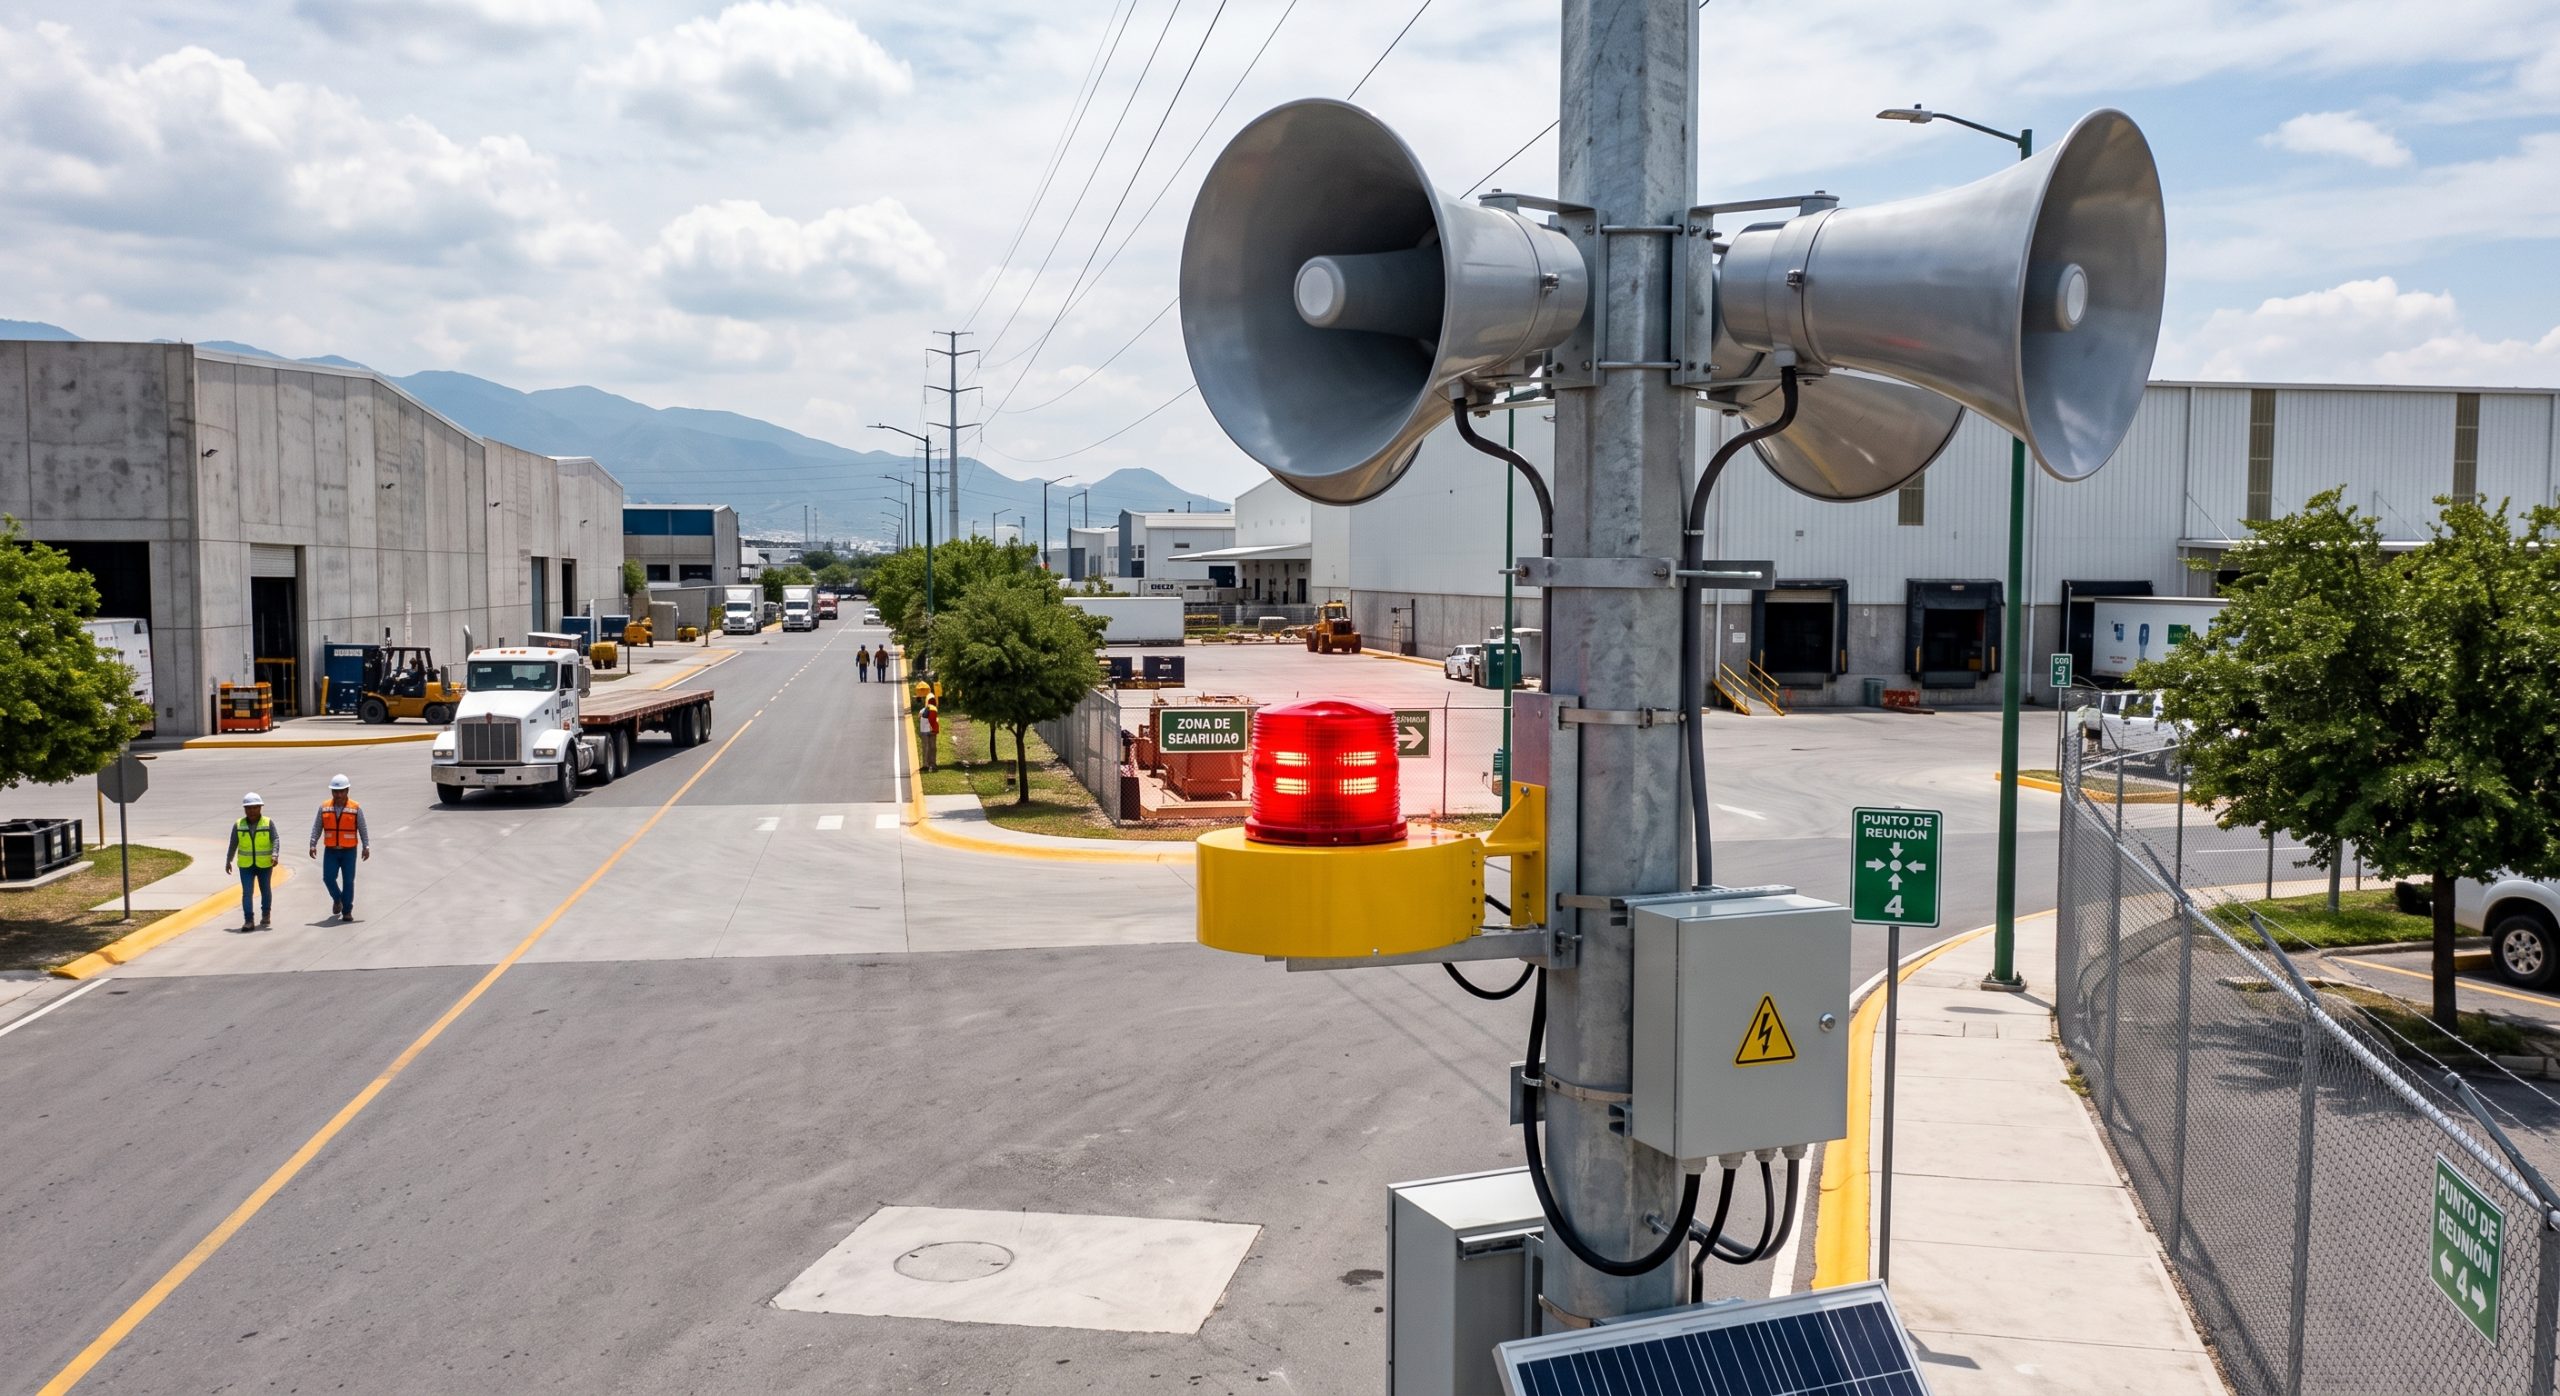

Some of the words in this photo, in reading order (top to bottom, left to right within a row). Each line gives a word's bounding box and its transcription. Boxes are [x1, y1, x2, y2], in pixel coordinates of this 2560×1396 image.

[1177, 718, 1211, 730] ZONA
[1214, 718, 1231, 730] DE
[1862, 814, 1909, 826] PUNTO
[1914, 817, 1932, 827] DE
[1865, 827, 1927, 840] REUNIÓN
[1884, 894, 1904, 918] 4
[2438, 1173, 2476, 1227] PUNTO
[2479, 1210, 2497, 1247] DE
[2438, 1207, 2492, 1279] REUNIÓN
[2456, 1266, 2468, 1302] 4
